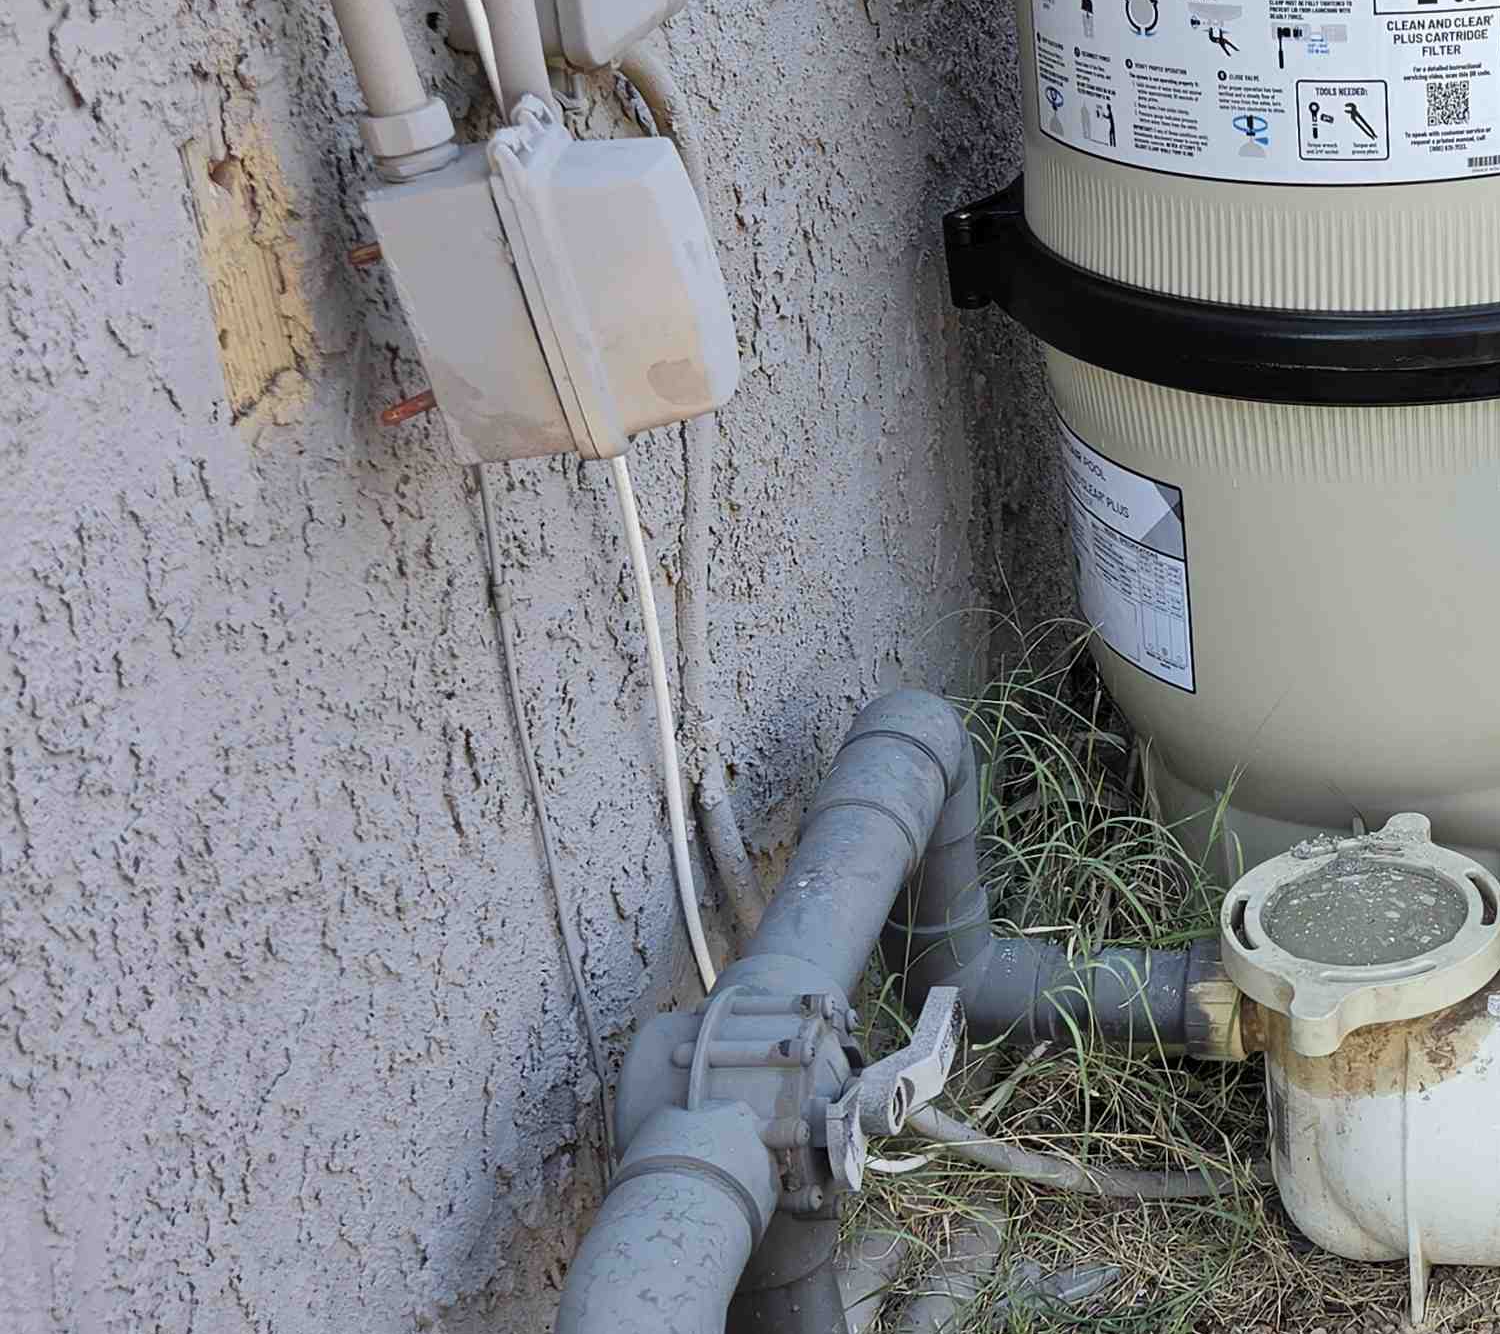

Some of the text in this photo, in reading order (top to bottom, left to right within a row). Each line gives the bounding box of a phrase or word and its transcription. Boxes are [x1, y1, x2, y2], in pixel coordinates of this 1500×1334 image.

[1387, 15, 1491, 31] CLEAN AND CLEAR
[1393, 28, 1489, 45] PLUS CARTRIDGE
[1422, 44, 1461, 57] FILTER
[1315, 87, 1337, 96] TOOLS
[1106, 496, 1130, 519] PLUS
